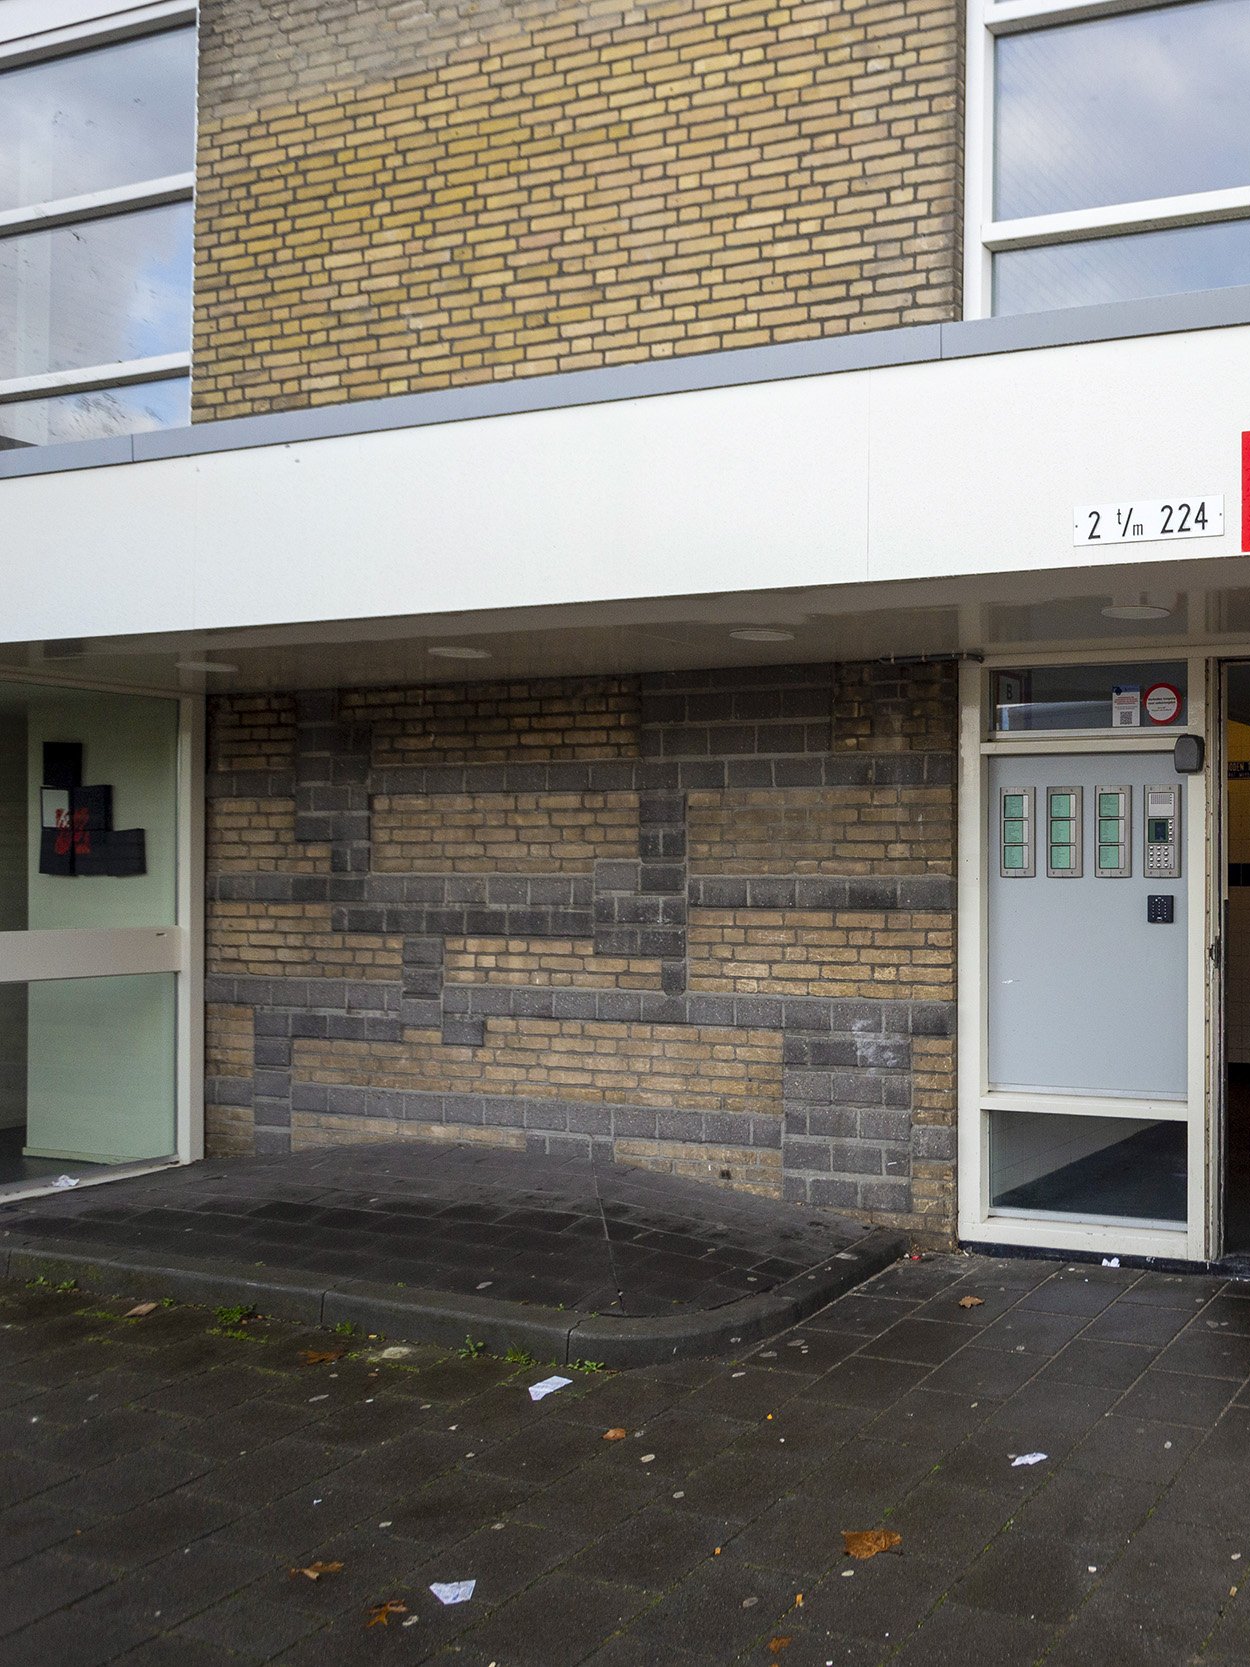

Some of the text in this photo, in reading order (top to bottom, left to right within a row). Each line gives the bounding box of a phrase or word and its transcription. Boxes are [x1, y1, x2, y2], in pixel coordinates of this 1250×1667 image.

[1088, 501, 1208, 540] 2 t/m 224
